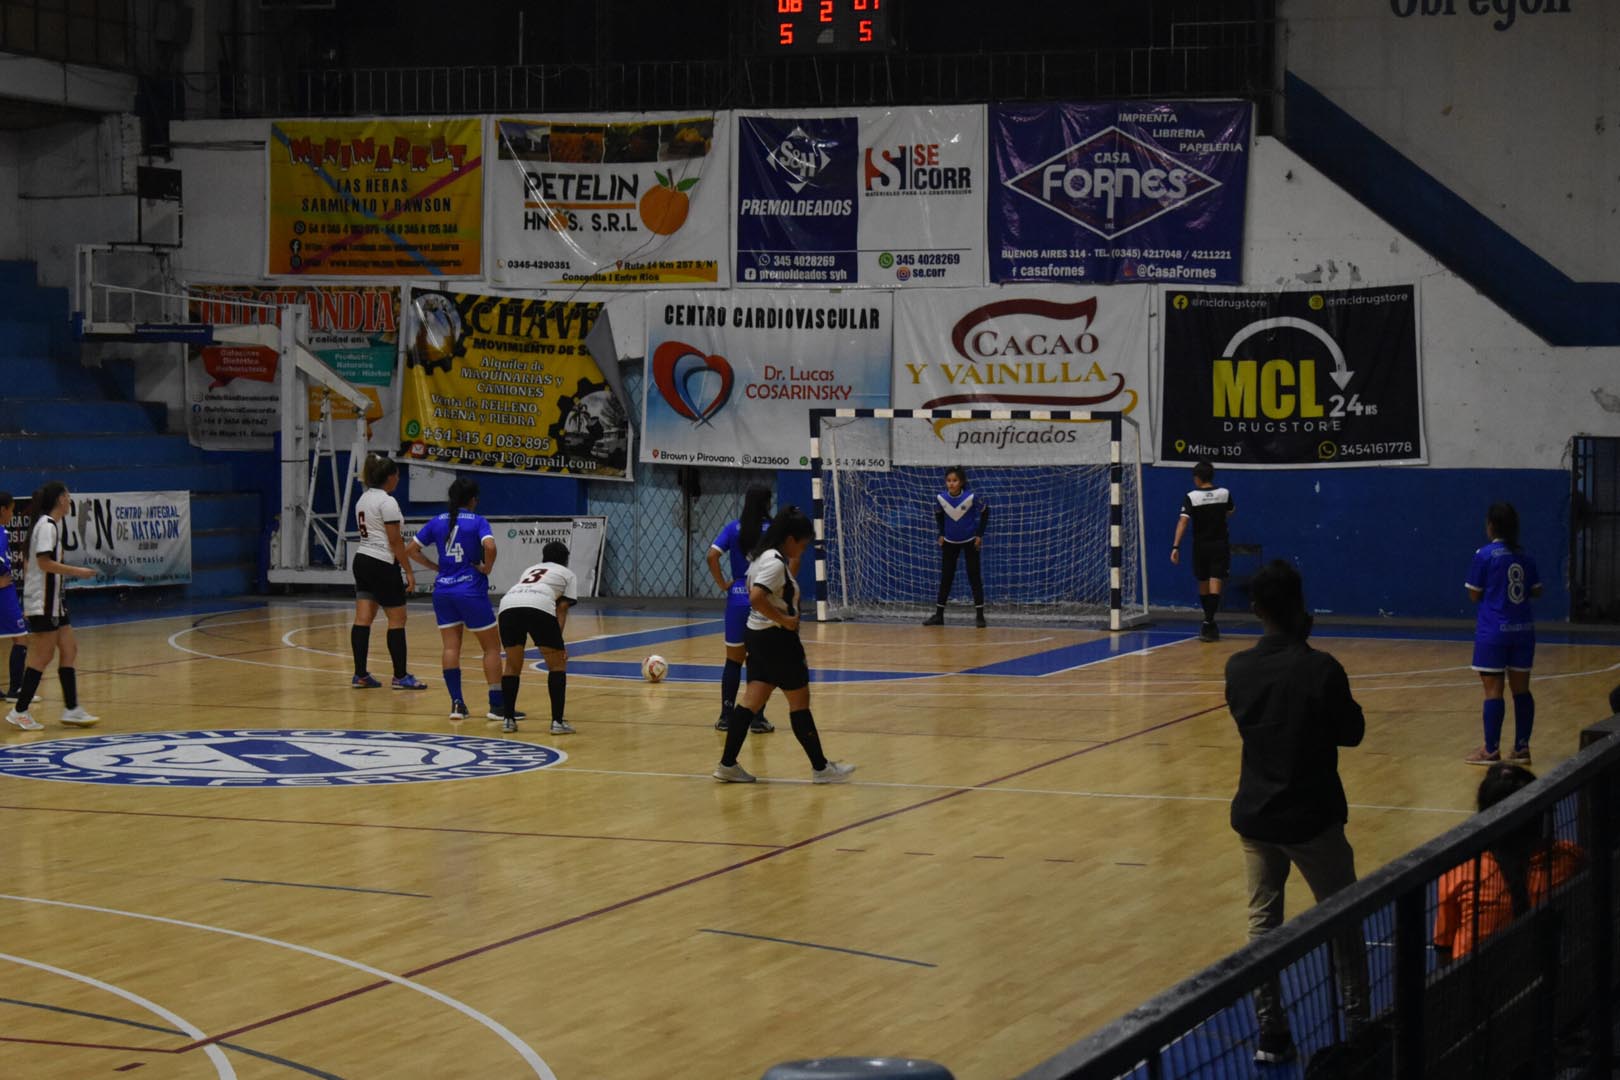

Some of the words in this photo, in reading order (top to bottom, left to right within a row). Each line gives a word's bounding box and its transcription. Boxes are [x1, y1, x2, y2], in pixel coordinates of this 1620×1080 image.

[820, 0, 833, 22] 2
[779, 22, 793, 45] 5
[858, 20, 872, 42] 5
[1118, 113, 1178, 123] IMPRENTA
[1152, 129, 1206, 138] LIBRERIA
[289, 136, 467, 173] MINIMARKET
[913, 144, 940, 166] SE
[1094, 152, 1131, 164] CASA
[337, 179, 361, 193] LAS
[366, 178, 409, 193] HERAS
[913, 167, 971, 190] CORR
[524, 173, 639, 201] PETELIN
[302, 197, 377, 213] SARMIENTO
[382, 198, 388, 211] Y
[740, 199, 852, 217] PREMOLDEADOS
[773, 255, 791, 266] 345
[793, 255, 836, 266] 4028269
[896, 254, 915, 265] 345
[917, 253, 960, 265] 4028269
[1001, 249, 1038, 259] BUENOS
[1040, 249, 1067, 259] AIRES
[1069, 249, 1086, 259] 314
[1111, 248, 1141, 260] (0345)
[1191, 249, 1231, 260] 4211221
[659, 261, 674, 269] Km
[912, 267, 946, 278] se.corr
[1020, 265, 1085, 277] casafornes
[1137, 265, 1217, 279] @CasaFornes
[829, 269, 847, 282] syh
[664, 304, 726, 327] CENTRO
[733, 306, 880, 330] CARDIOVASCULAR
[473, 338, 555, 355] MOVIMIENTO
[558, 345, 574, 355] DE
[578, 346, 591, 356] S
[971, 330, 1099, 357] CACAO
[481, 356, 528, 371] Alquiler
[530, 361, 544, 371] de
[460, 368, 553, 385] MAQUINARIAS
[555, 377, 564, 386] y
[764, 365, 785, 381] Dr.
[790, 366, 834, 381] Lucas
[906, 363, 928, 384] Y
[940, 361, 1107, 384] VAINILLA
[476, 383, 544, 398] CAMIONES
[745, 383, 852, 401] COSARINSKY
[1213, 358, 1324, 420] MCL
[464, 398, 478, 408] de
[433, 408, 477, 421] ARENA
[489, 412, 536, 426] PIEDRA
[1223, 420, 1343, 433] DRUGSTORE
[423, 428, 452, 441] +54
[456, 430, 480, 443] 345
[484, 432, 492, 446] 4
[956, 425, 1077, 449] panificados
[1188, 443, 1220, 456] Mitre
[1222, 445, 1241, 456] 130
[1340, 441, 1412, 455] 3454161778
[428, 445, 597, 470] ezechaves13@gmail.com
[660, 451, 688, 460] Brown
[689, 454, 695, 462] y
[697, 452, 735, 462] Pirovano
[752, 456, 789, 465] 4223600
[868, 458, 885, 467] 560
[115, 506, 142, 519] CENTRO
[146, 505, 180, 518] INTEGRAL
[116, 522, 129, 540] DE
[537, 528, 571, 536] MARTIN
[445, 524, 464, 563] 4
[521, 568, 548, 584] 3
[1507, 562, 1524, 605] 8
